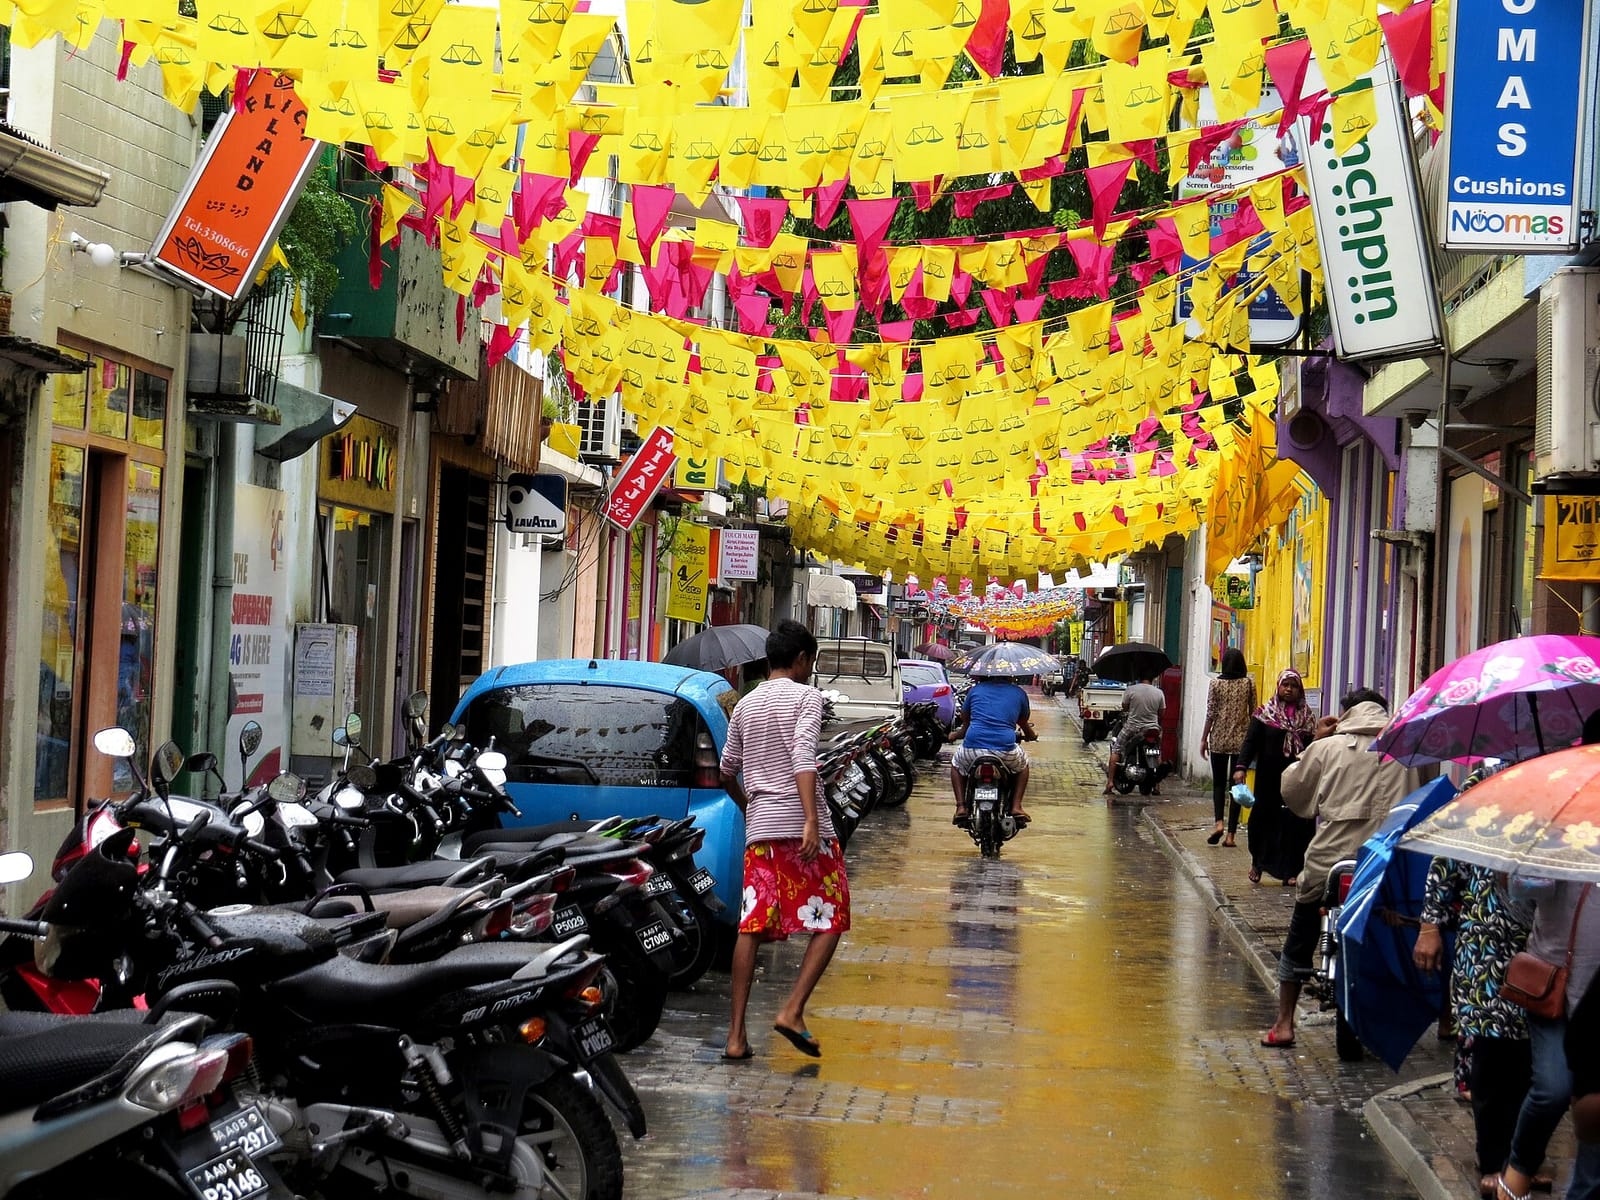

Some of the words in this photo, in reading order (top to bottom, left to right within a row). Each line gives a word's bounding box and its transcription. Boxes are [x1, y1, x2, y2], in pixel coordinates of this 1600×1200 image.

[1453, 175, 1566, 197] Cushions
[1452, 209, 1564, 235] Noomas
[185, 215, 250, 259] Tel:3308646
[624, 435, 673, 500] MIZAJ
[515, 516, 557, 529] LAVAZZA
[1558, 502, 1600, 525] 201
[233, 552, 249, 585] THE
[231, 592, 273, 626] SUPERFAST
[230, 633, 242, 666] 4G
[243, 634, 252, 666] IS
[252, 634, 272, 665] HERE
[554, 915, 585, 934] P5029
[643, 930, 670, 950] C7008
[220, 1125, 268, 1154] 297
[203, 1168, 262, 1200] P3146
